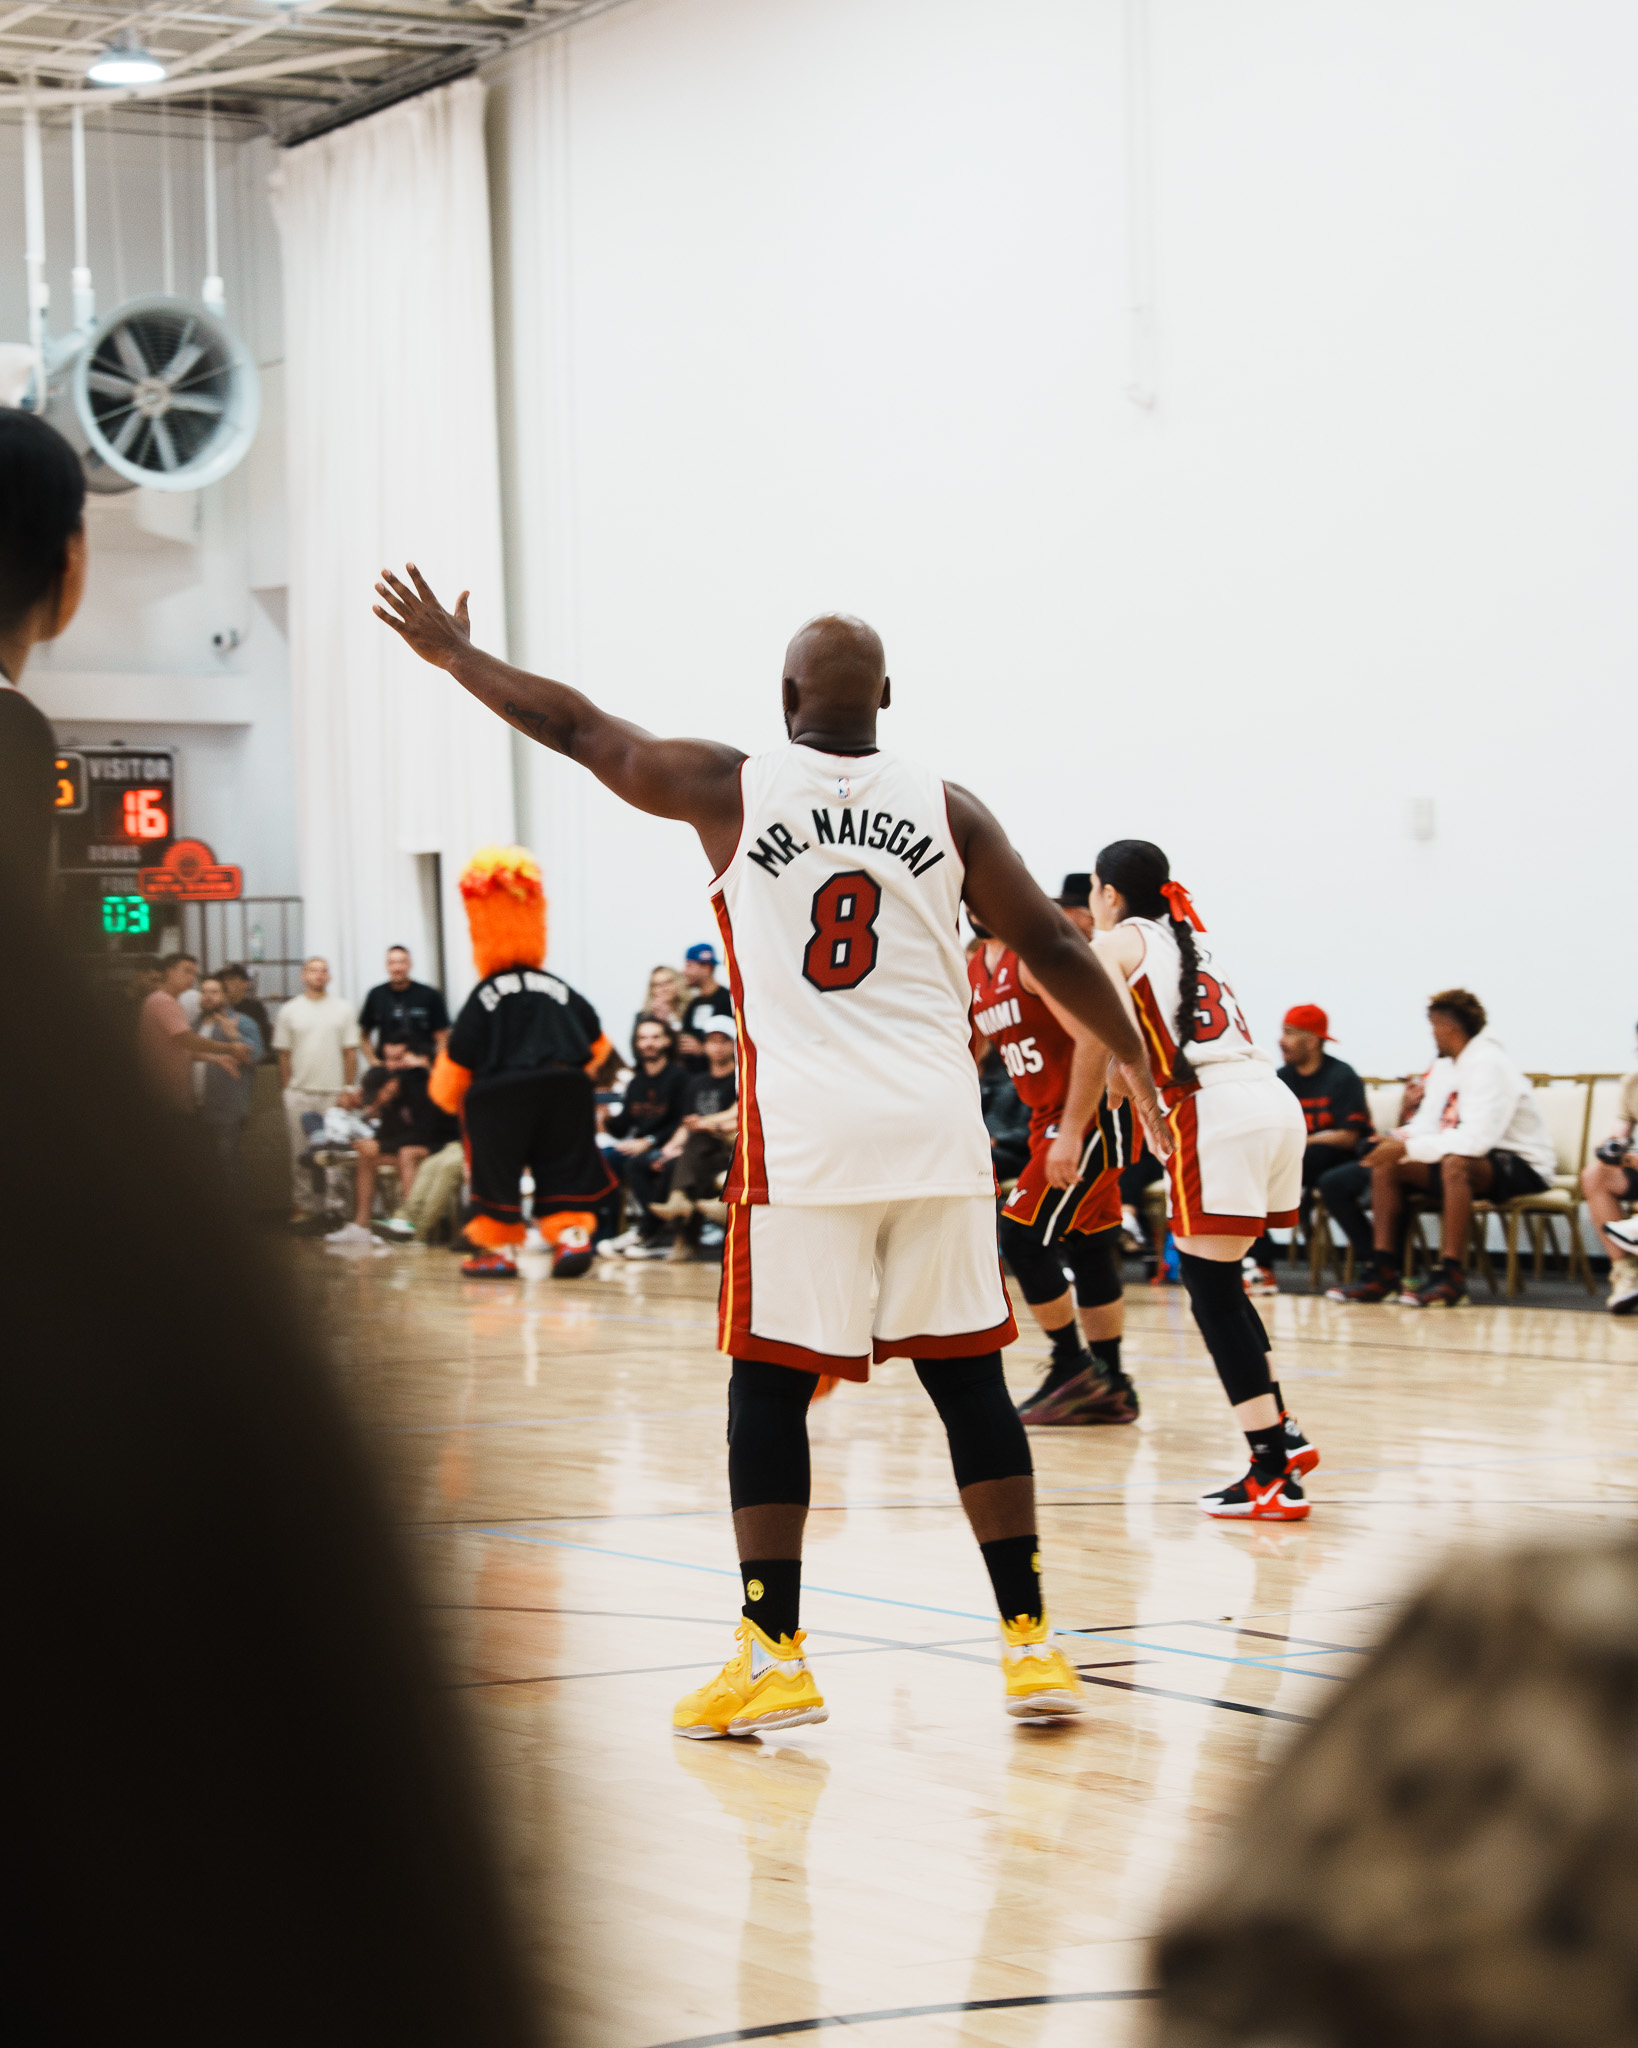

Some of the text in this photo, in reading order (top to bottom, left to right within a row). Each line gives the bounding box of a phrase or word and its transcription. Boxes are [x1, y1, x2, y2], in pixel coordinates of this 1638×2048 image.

[87, 757, 171, 781] VISITOR
[123, 789, 169, 838] 16
[747, 808, 945, 878] MR. NAISGAI
[102, 896, 150, 933] 03
[802, 869, 882, 993] 8
